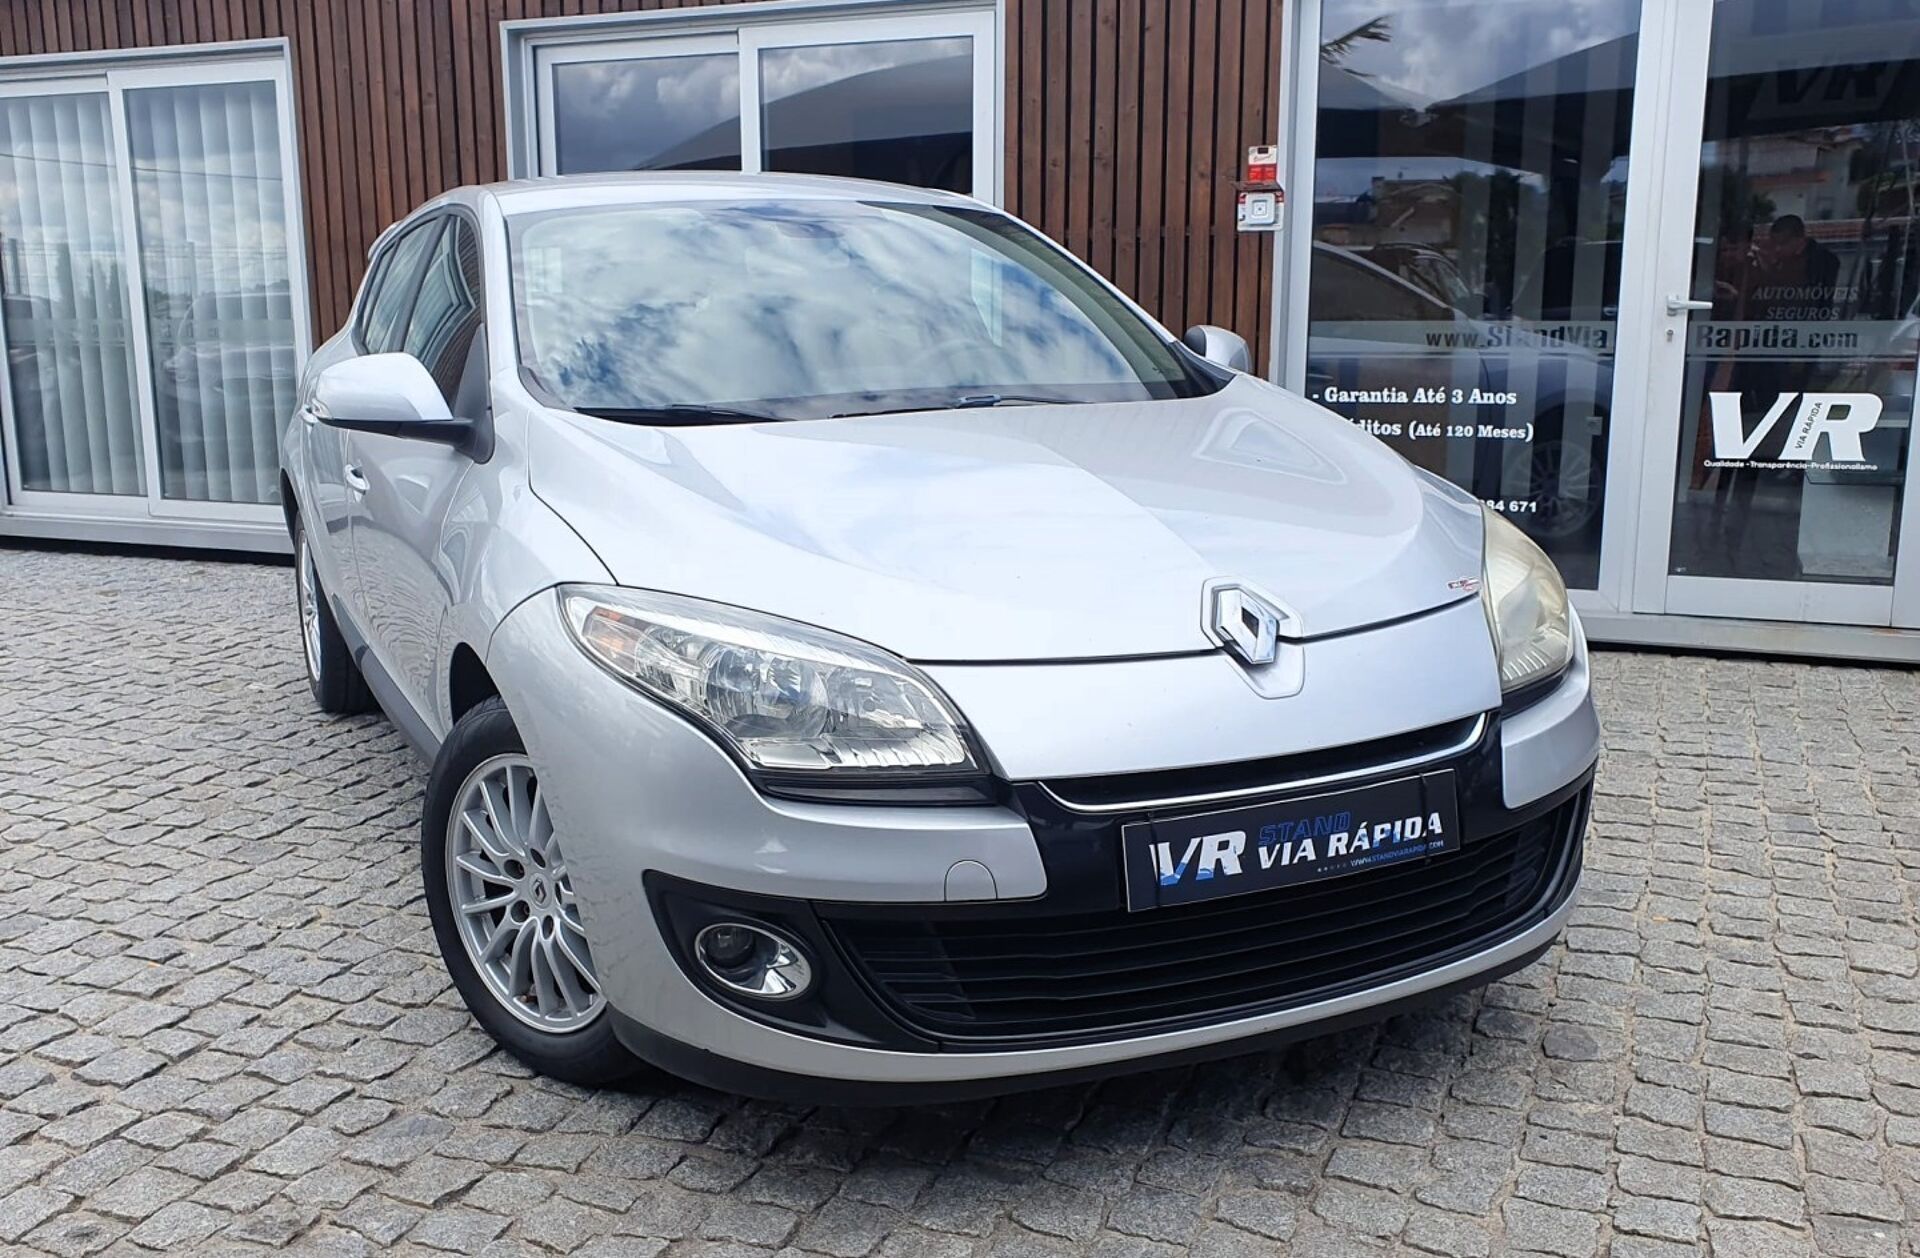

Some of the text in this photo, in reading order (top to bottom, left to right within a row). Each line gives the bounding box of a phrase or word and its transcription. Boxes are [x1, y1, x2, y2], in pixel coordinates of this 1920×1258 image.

[1766, 306, 1840, 321] SEGUROS
[1426, 325, 1858, 350] www.StndVia Rapida.com
[1325, 386, 1409, 404] Garantia
[1413, 387, 1446, 404] Até
[1452, 389, 1464, 405] 3
[1468, 389, 1517, 405] Anos
[1408, 420, 1441, 440] (Até
[1446, 425, 1473, 438] 120
[1478, 422, 1534, 442] Meses)
[1709, 392, 1883, 462] VR
[1509, 500, 1537, 512] 671
[1258, 811, 1353, 845] STAND
[1149, 812, 1443, 887] VR VIA RÁPIDA
